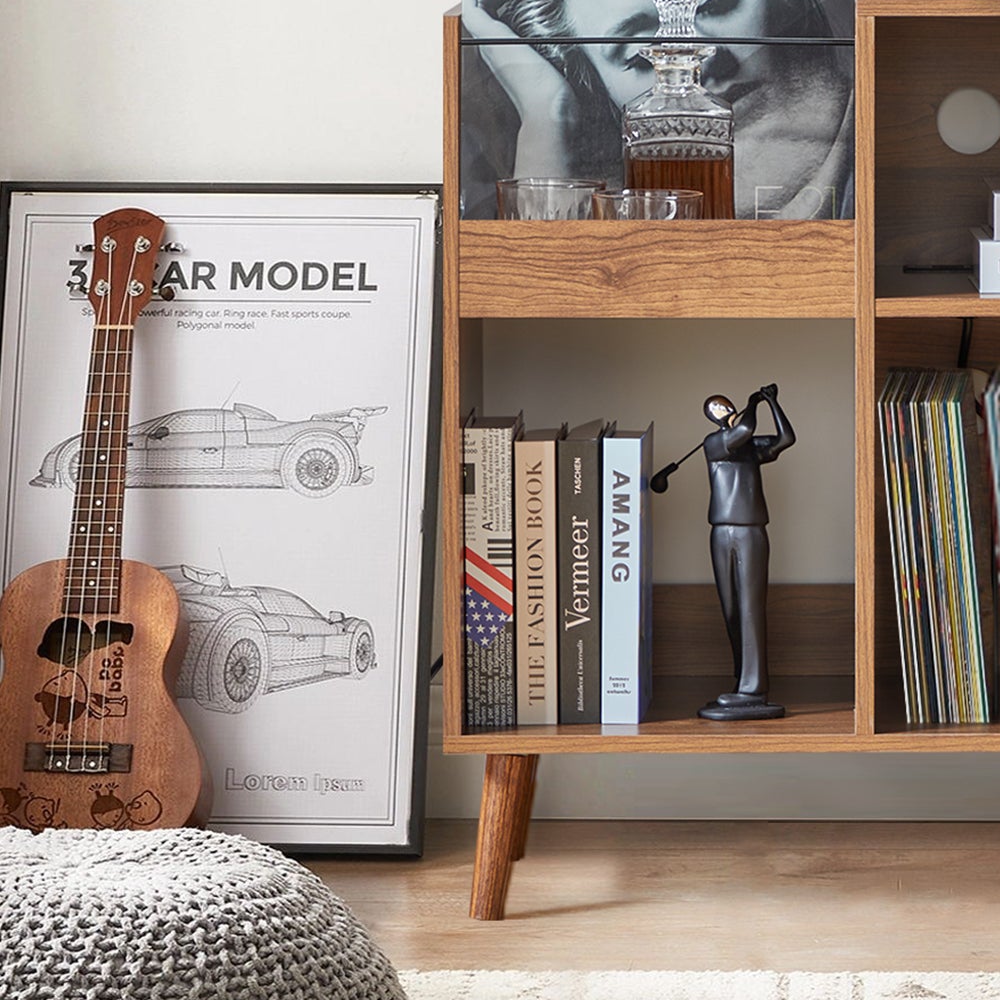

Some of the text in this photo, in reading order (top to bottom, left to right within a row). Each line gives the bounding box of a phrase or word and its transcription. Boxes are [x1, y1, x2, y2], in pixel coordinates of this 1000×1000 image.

[152, 261, 217, 291] AR
[230, 262, 378, 292] MODEL
[174, 308, 203, 319] racing
[223, 309, 246, 319] Ring
[271, 309, 290, 318] Fast
[291, 310, 320, 319] sports
[177, 320, 223, 331] Polygonal
[574, 457, 582, 495] TASCHEN
[611, 469, 631, 584] AMANG
[525, 460, 545, 706] THE FASHION BOOK
[565, 515, 592, 632] Vermeer
[224, 768, 366, 794] Lorem Ipsum
